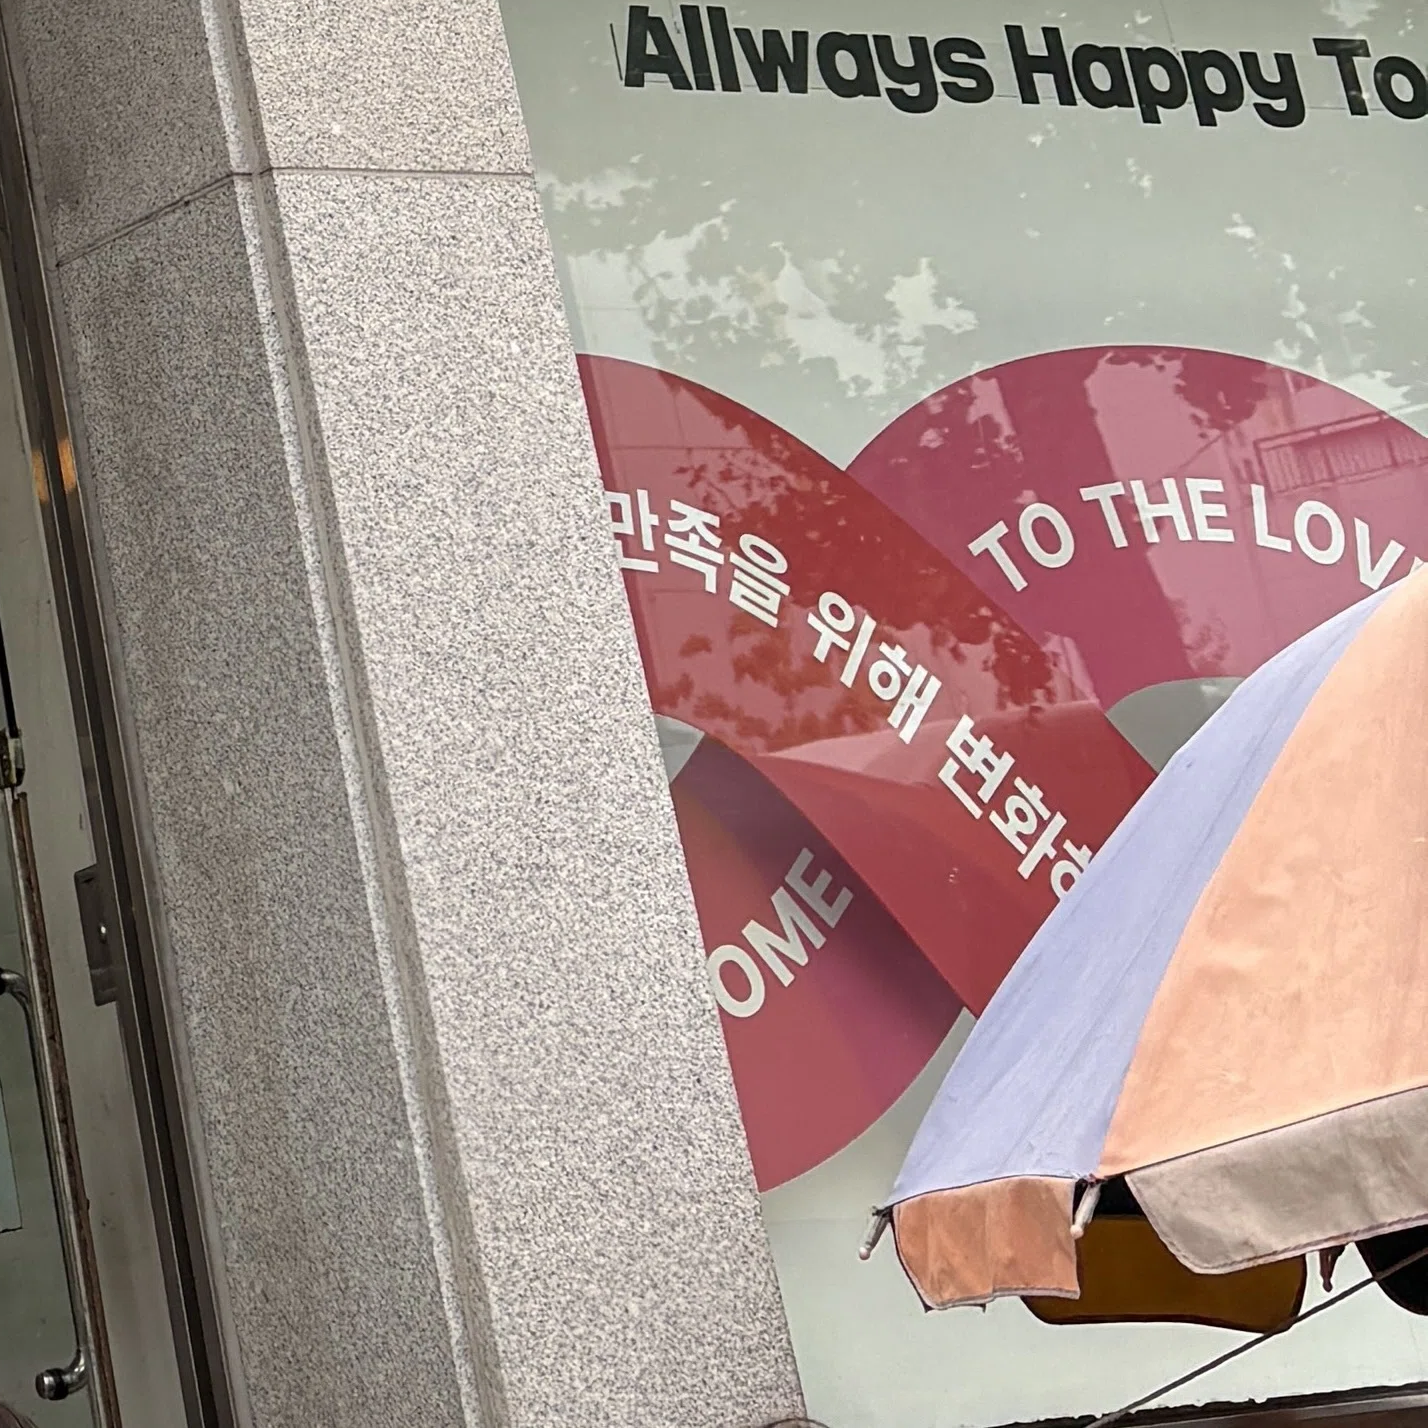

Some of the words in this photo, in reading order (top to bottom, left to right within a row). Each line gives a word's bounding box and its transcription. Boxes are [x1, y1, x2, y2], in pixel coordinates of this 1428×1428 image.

[623, 4, 995, 114] Allways
[1005, 24, 1307, 128] Happy
[969, 502, 1075, 593] TO
[1080, 477, 1236, 544] THE
[1251, 483, 1424, 591] LOV
[604, 489, 791, 629] 만족을
[806, 591, 944, 744] 위해
